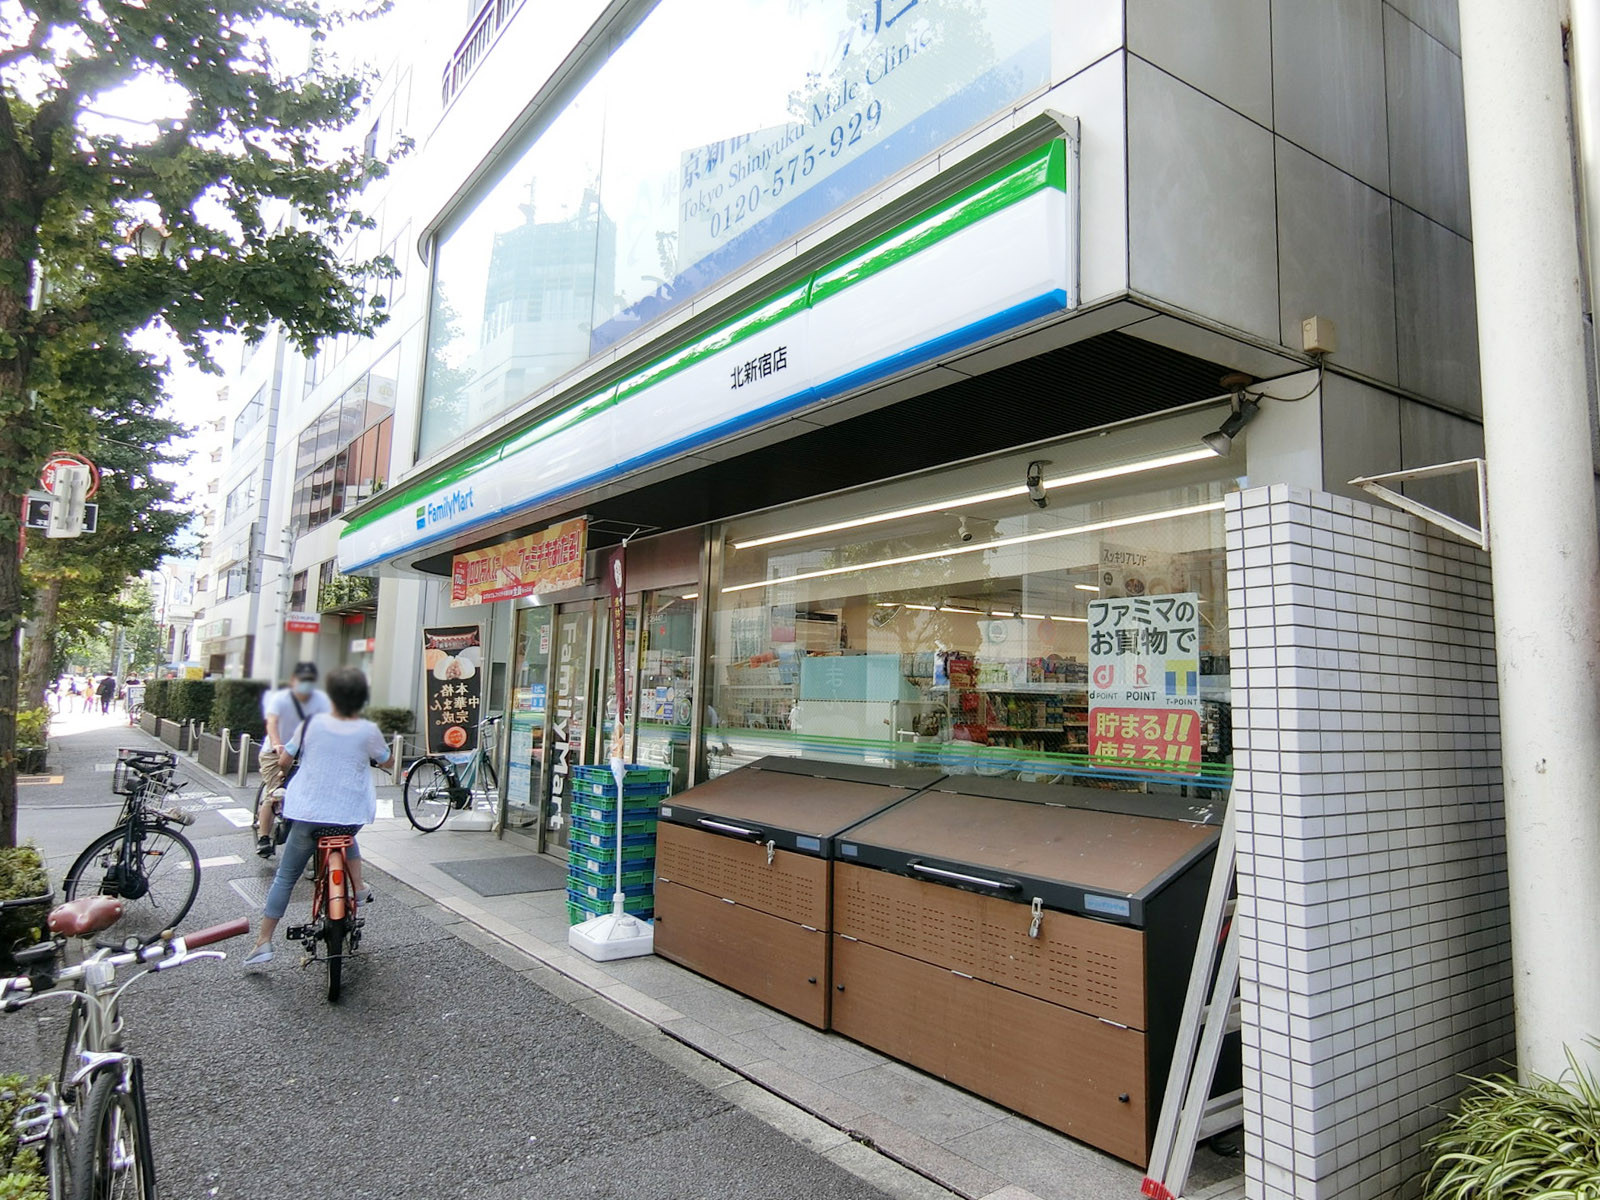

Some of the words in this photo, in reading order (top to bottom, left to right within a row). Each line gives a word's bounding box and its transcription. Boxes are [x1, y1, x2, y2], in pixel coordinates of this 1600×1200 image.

[682, 183, 723, 223] Tokyo
[813, 79, 858, 127] Male
[866, 28, 932, 85] Clinic
[711, 100, 881, 238] 0120-575-929
[730, 346, 787, 389] 北新宿店
[427, 487, 473, 525] FamilyMart
[1089, 598, 1195, 629] ファミマの
[1090, 627, 1197, 656] お買物で
[1126, 691, 1157, 701] POINT
[1166, 698, 1198, 706] T-POINT
[550, 622, 577, 830] FamilyMart
